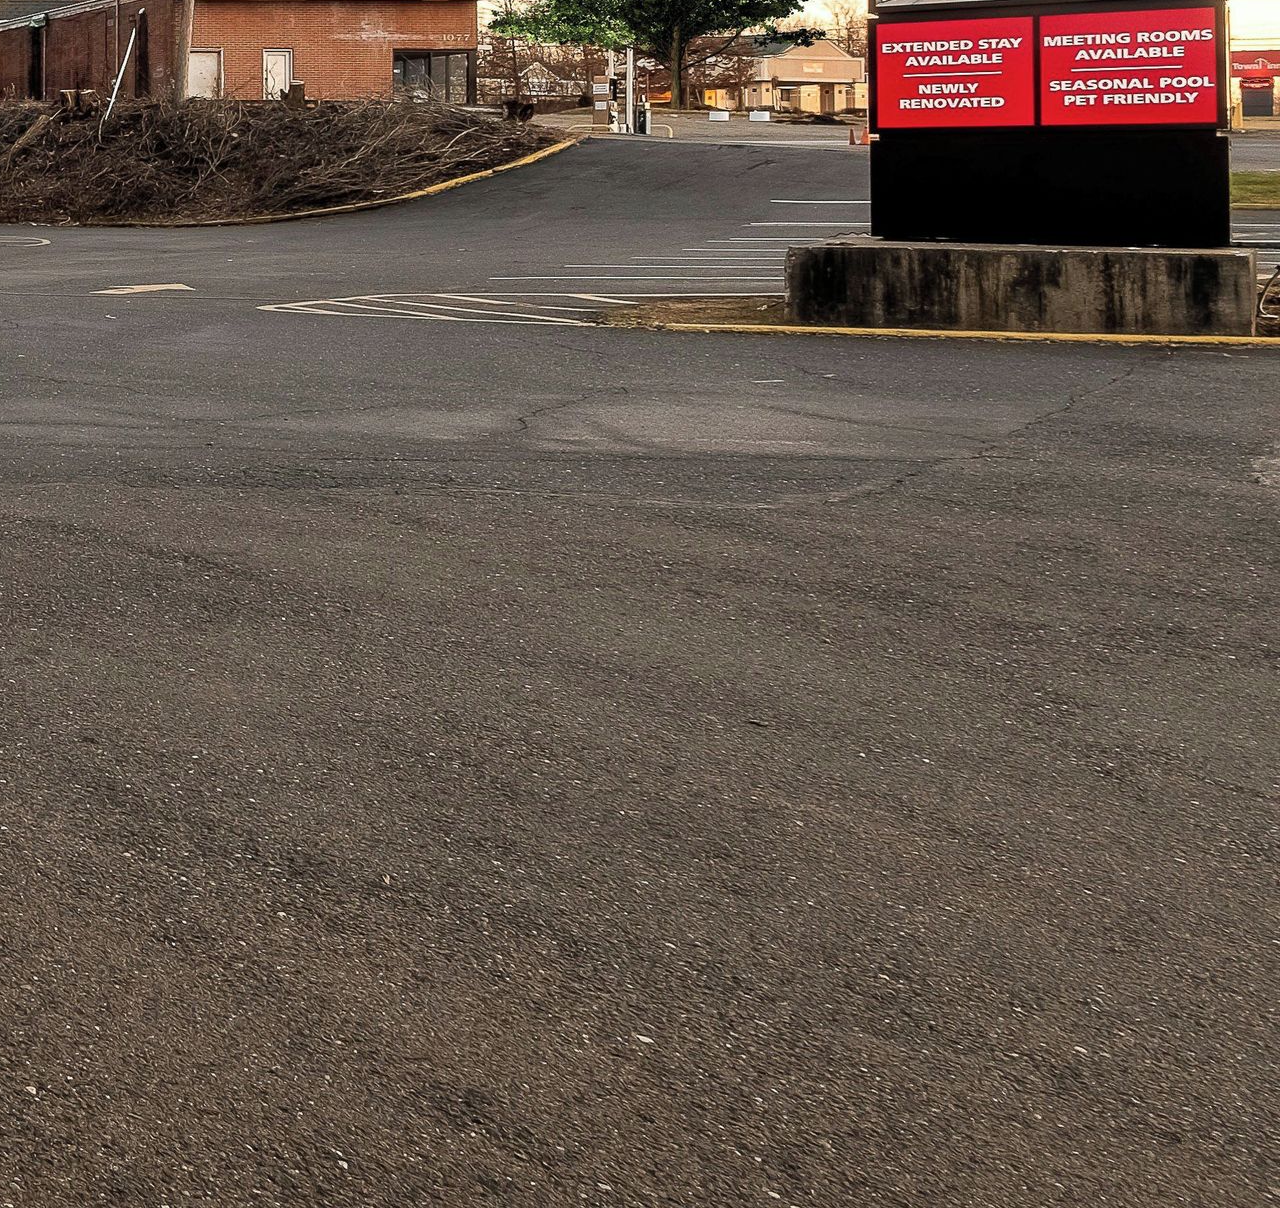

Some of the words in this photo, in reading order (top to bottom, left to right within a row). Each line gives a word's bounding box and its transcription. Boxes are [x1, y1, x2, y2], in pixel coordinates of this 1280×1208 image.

[442, 33, 471, 42] 1077
[1043, 32, 1131, 47] MEETING
[1137, 29, 1213, 43] ROOMS
[881, 39, 974, 54] EXTENDED
[978, 37, 1022, 50] STAY
[905, 53, 1003, 67] AVAILABLE
[1075, 46, 1185, 60] AVAILABLE
[918, 83, 979, 94] NEWLY
[1049, 78, 1154, 91] SEASONAL
[1159, 76, 1215, 88] POOL
[899, 97, 1005, 109] RENOVATED
[1063, 94, 1098, 106] PET
[1103, 92, 1199, 105] FRIENDLY
